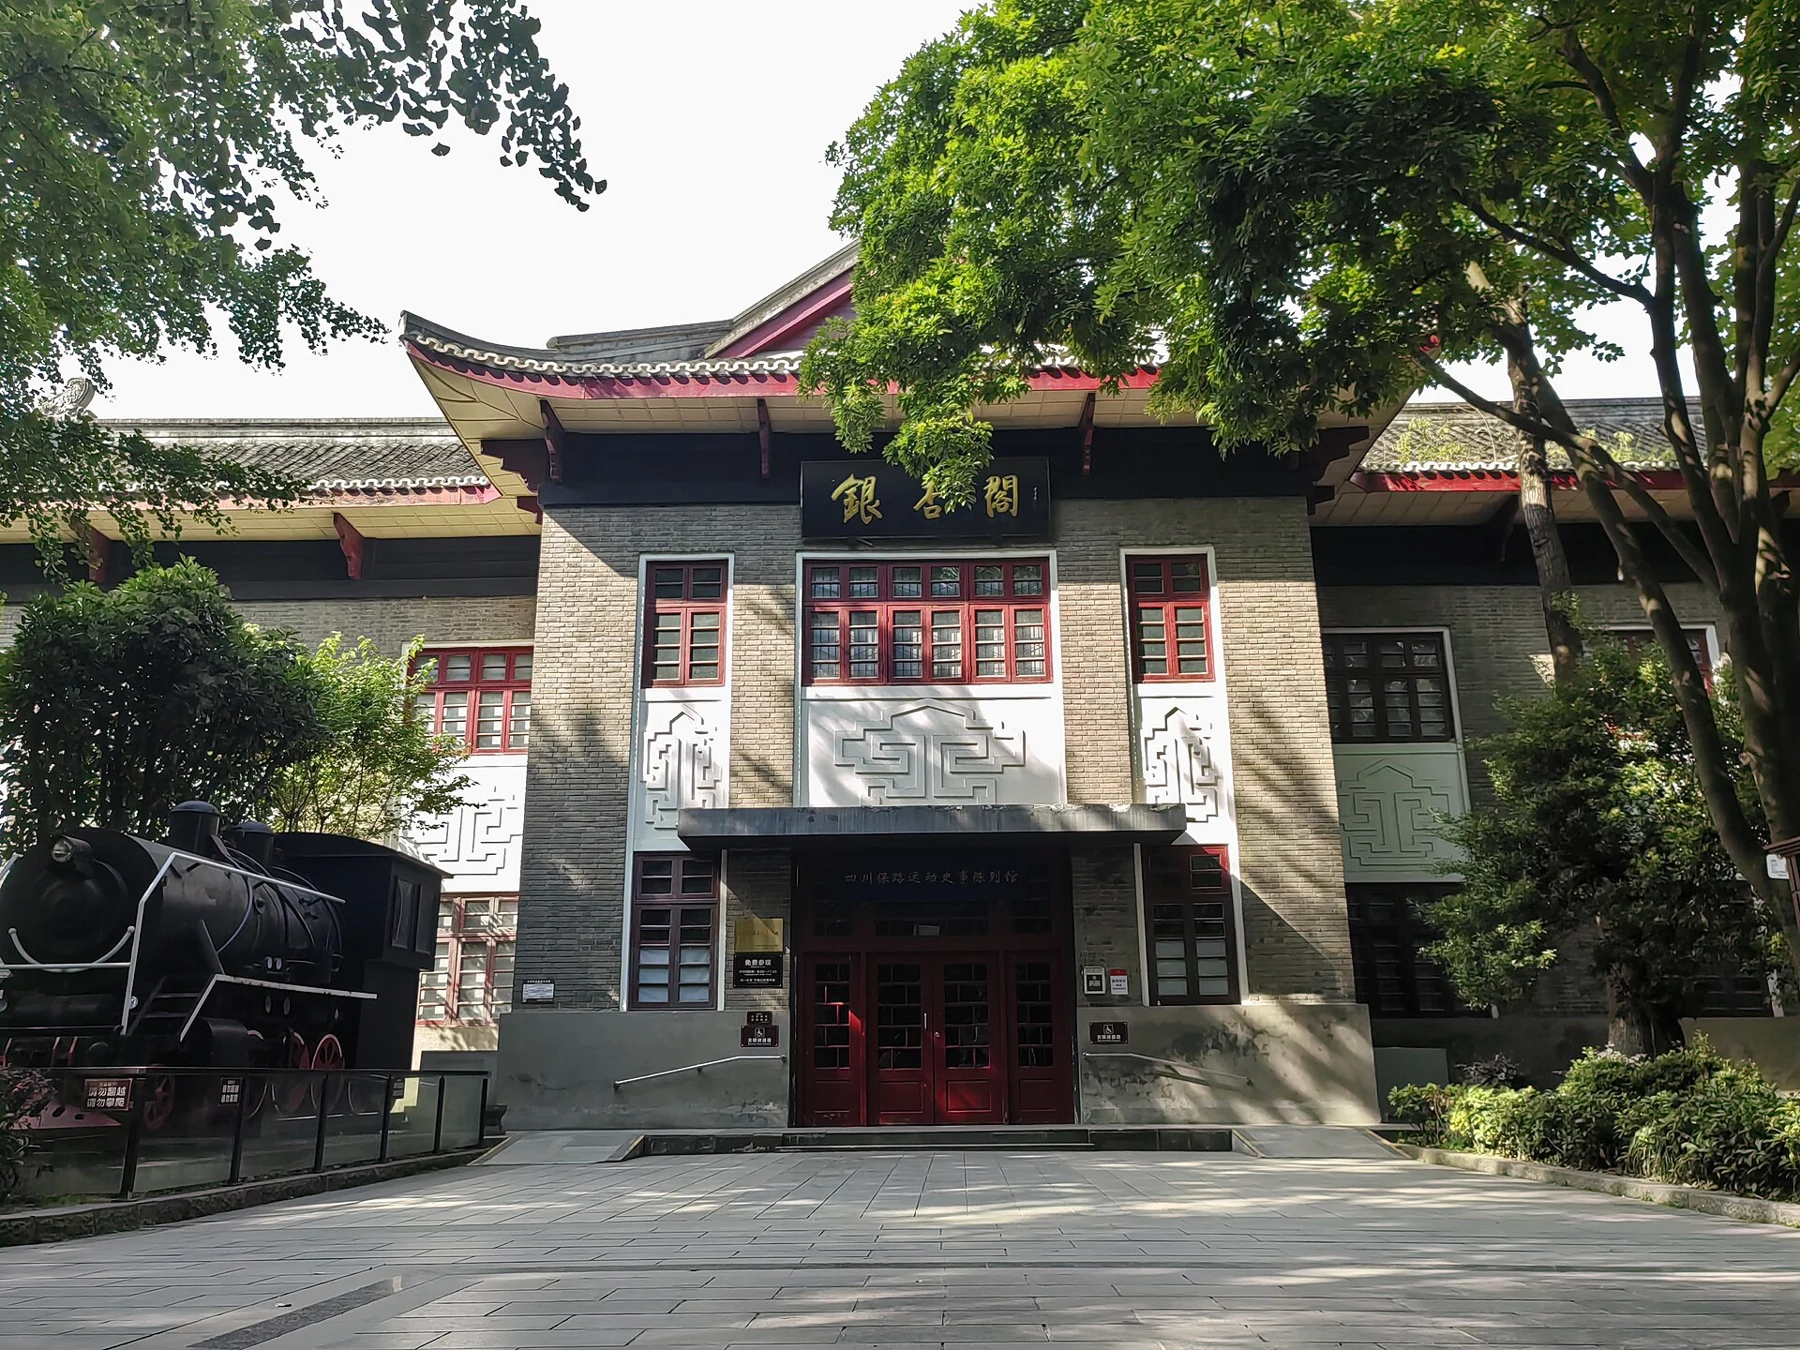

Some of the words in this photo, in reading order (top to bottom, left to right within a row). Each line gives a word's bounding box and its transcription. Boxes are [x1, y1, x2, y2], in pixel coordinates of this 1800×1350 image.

[845, 870, 1018, 884] 四川保路运动史事陈列馆
